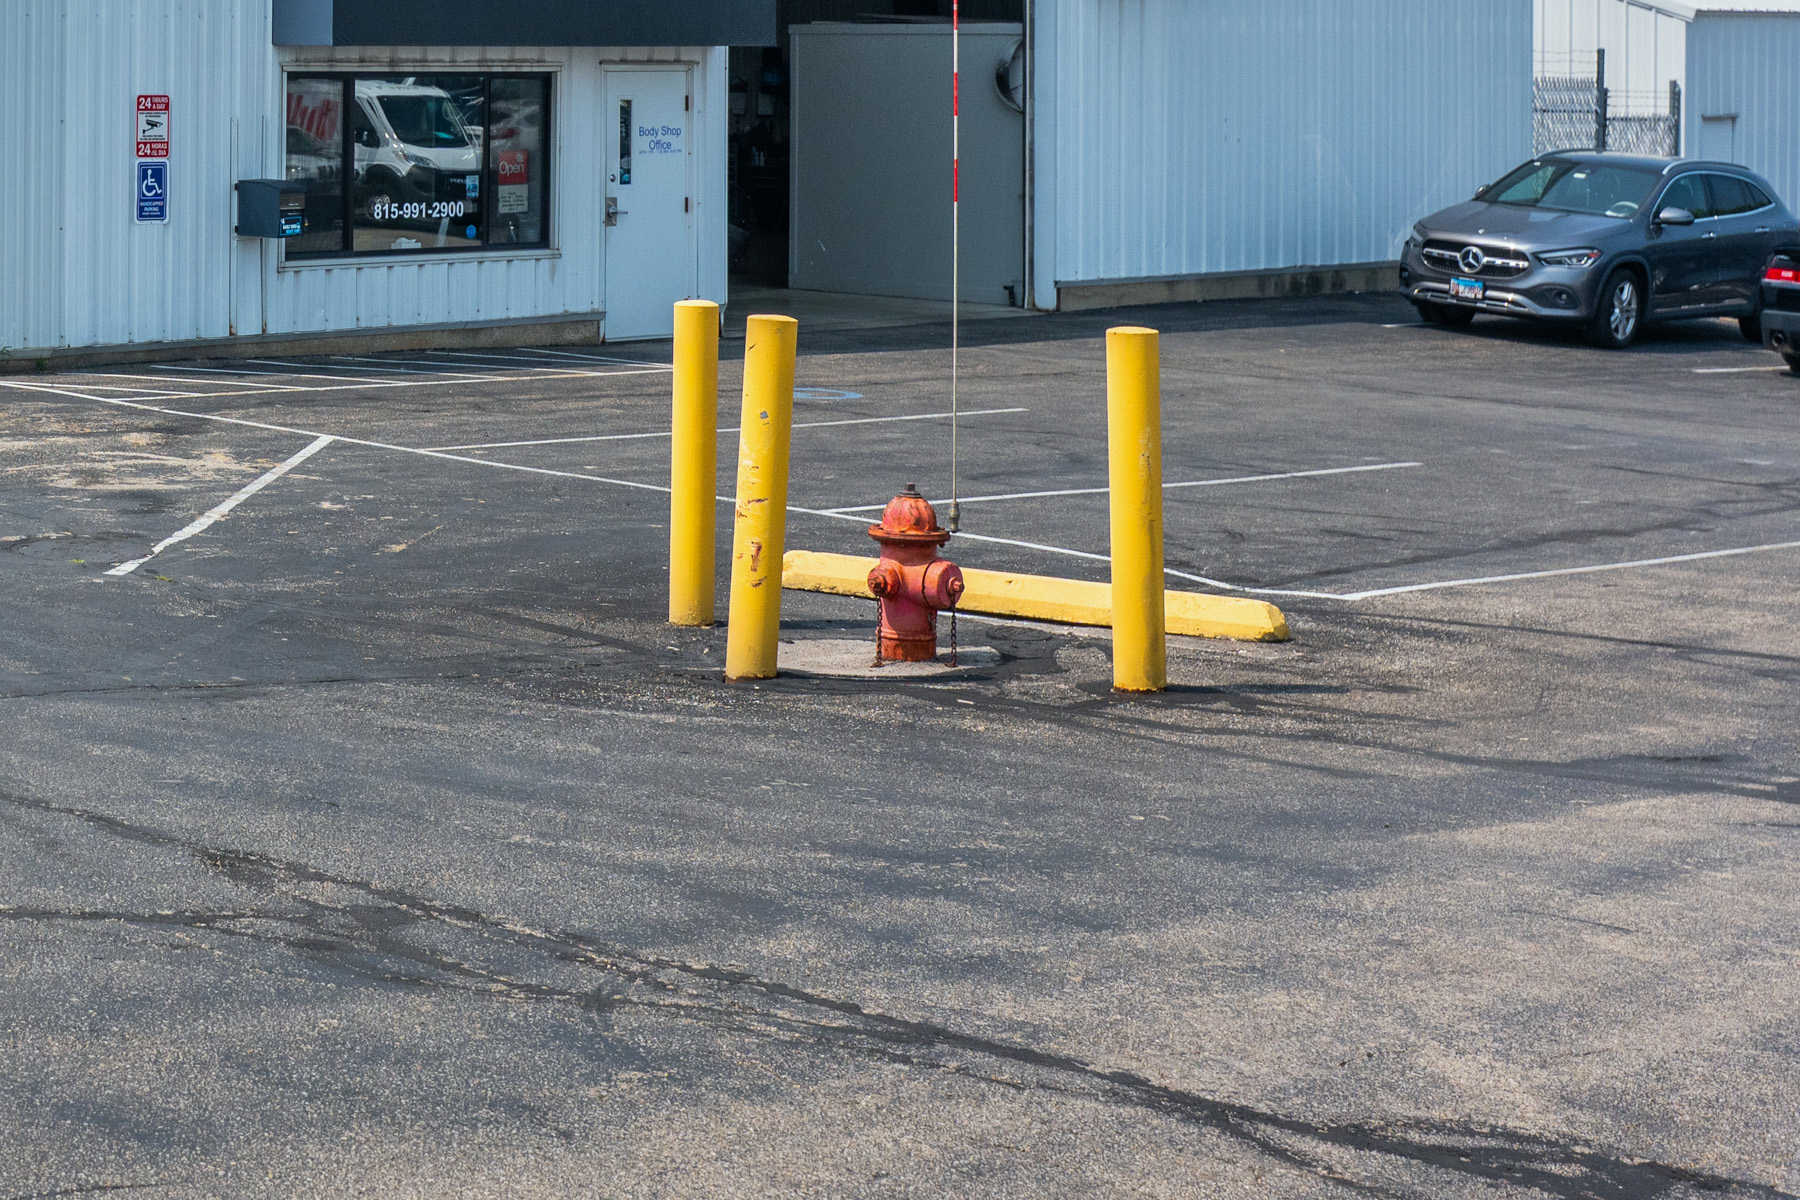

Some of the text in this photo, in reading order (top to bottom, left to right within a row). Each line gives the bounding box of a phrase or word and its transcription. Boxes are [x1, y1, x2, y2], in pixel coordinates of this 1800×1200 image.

[139, 97, 151, 109] 24
[638, 125, 681, 138] Body Shop
[138, 143, 151, 156] 24
[648, 139, 672, 150] Office
[499, 161, 525, 176] Open
[374, 201, 464, 219] 815-991-2900
